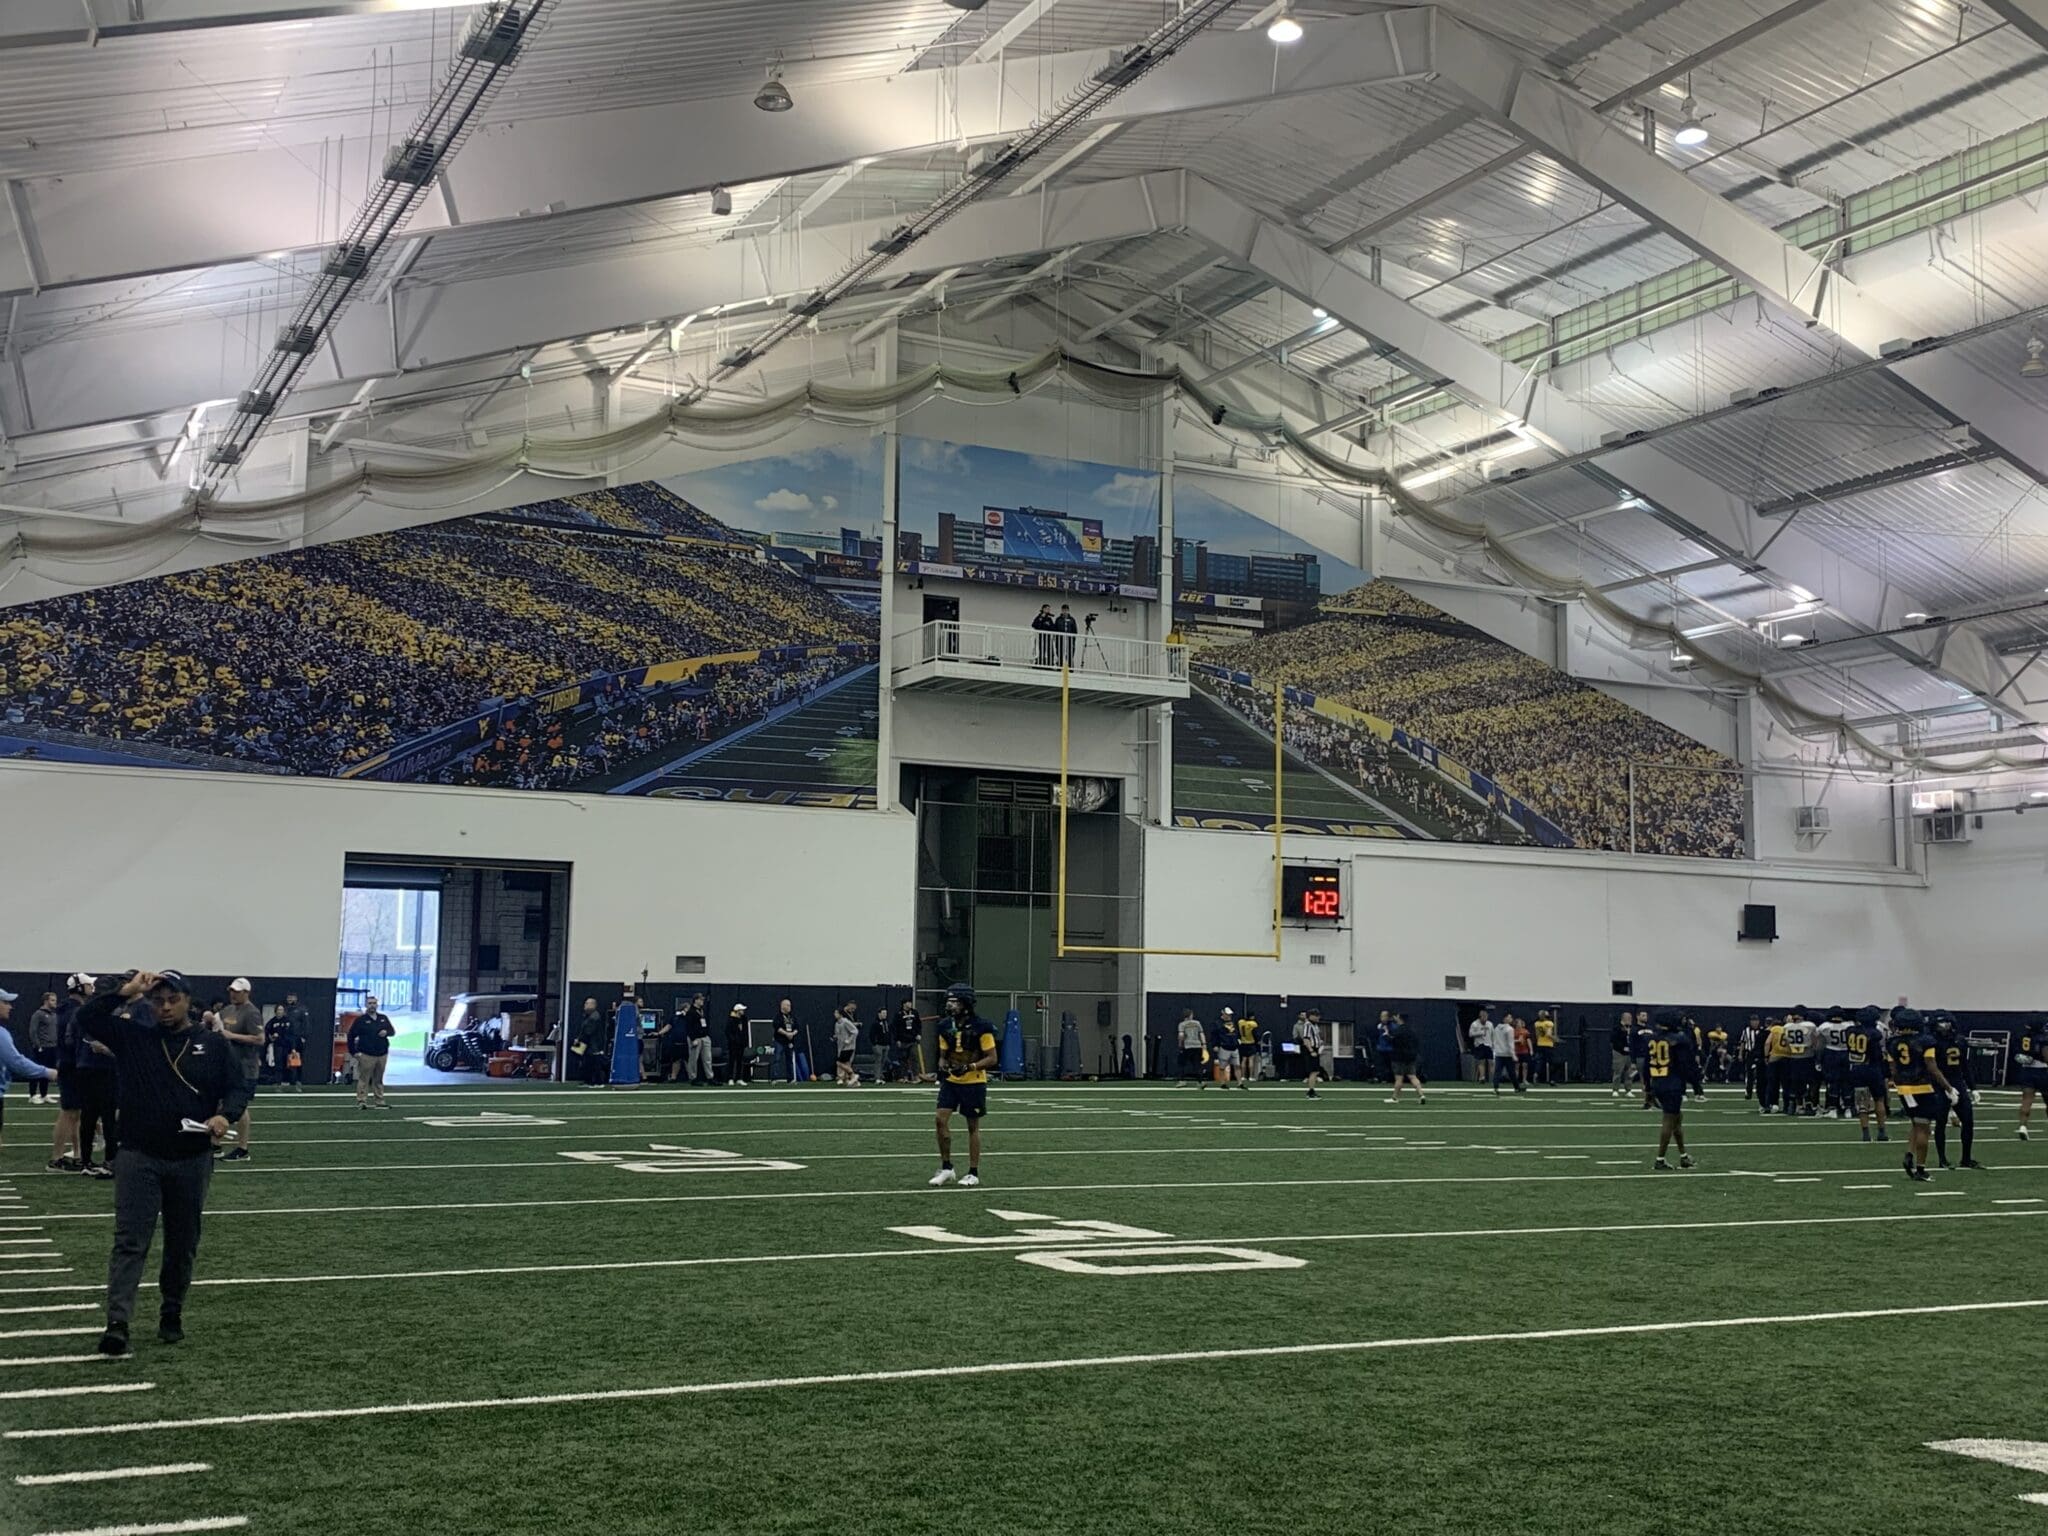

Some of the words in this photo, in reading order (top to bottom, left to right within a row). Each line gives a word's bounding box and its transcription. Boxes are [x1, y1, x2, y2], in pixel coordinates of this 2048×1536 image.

[1304, 890, 1338, 915] 1:22
[1787, 1029, 1804, 1045] 58
[1847, 1032, 1868, 1054] 40
[1897, 1042, 1911, 1066] 3
[1946, 1047, 1960, 1066] 2
